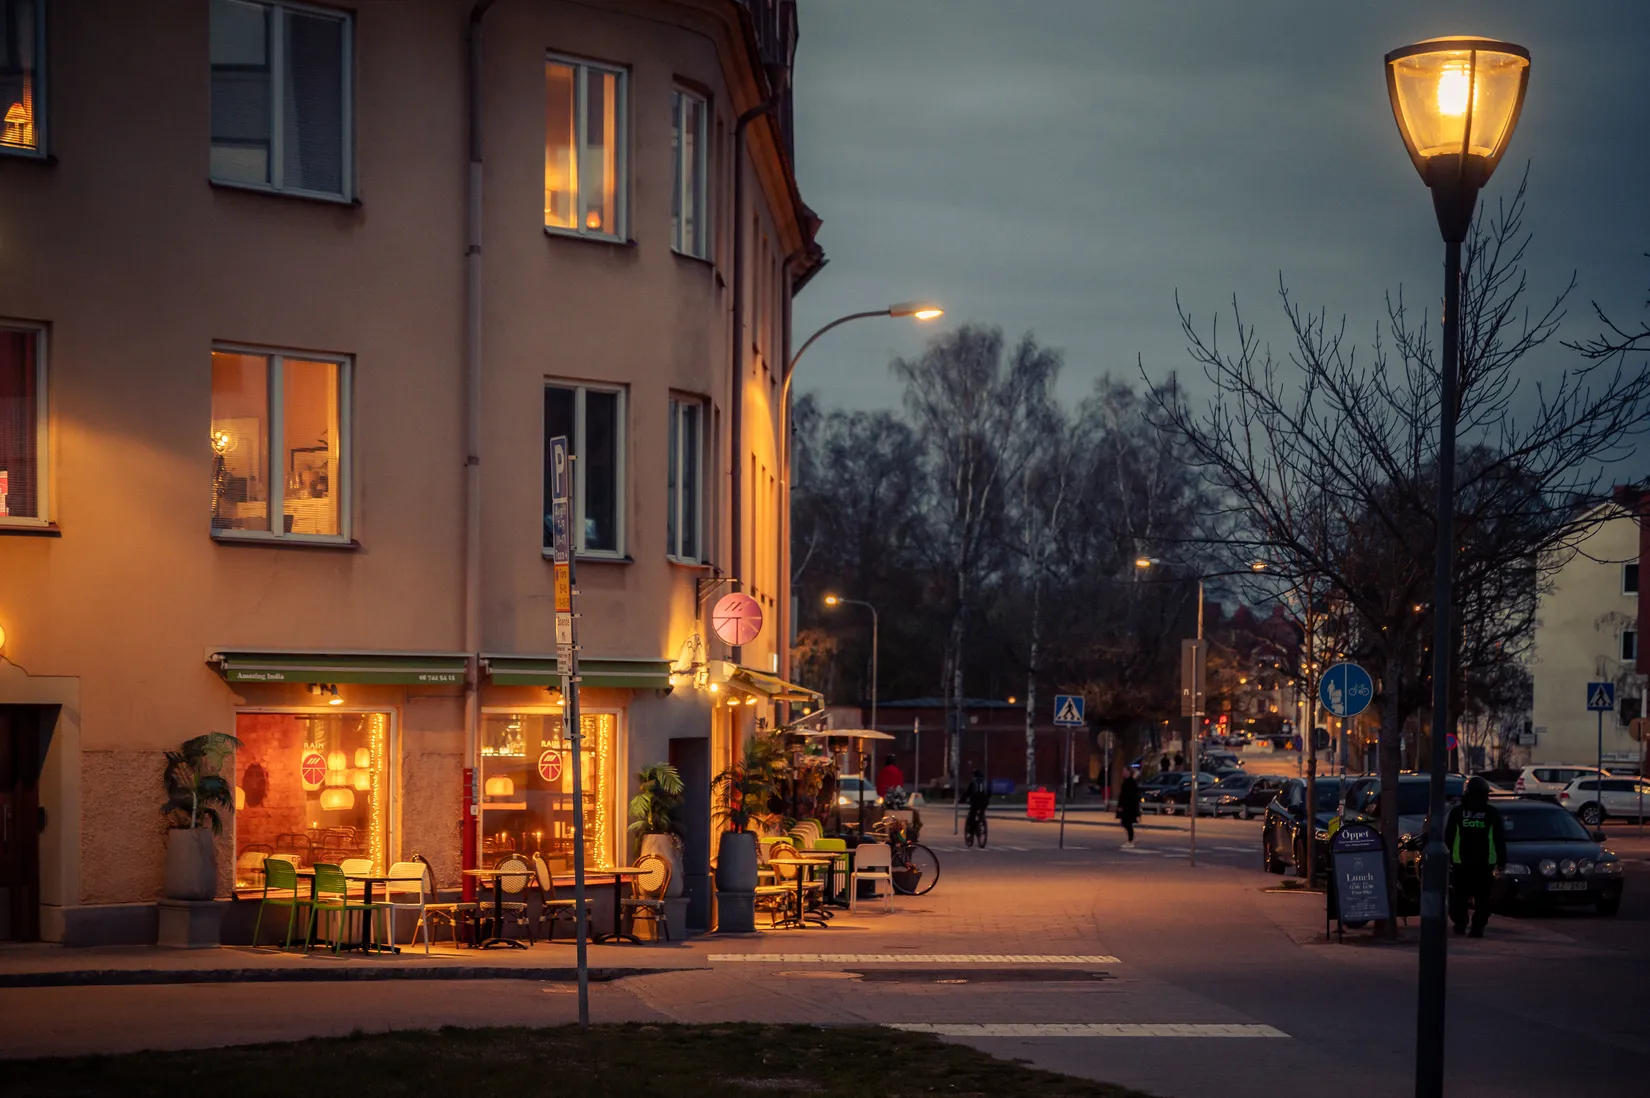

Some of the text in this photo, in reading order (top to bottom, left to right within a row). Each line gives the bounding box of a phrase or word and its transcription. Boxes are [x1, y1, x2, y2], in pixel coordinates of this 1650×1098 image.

[554, 443, 565, 494] P
[237, 672, 266, 681] Amazing
[541, 740, 560, 748] RAIN
[1462, 818, 1486, 828] Eats
[1341, 829, 1369, 841] Öppet
[1346, 872, 1374, 882] Lunch
